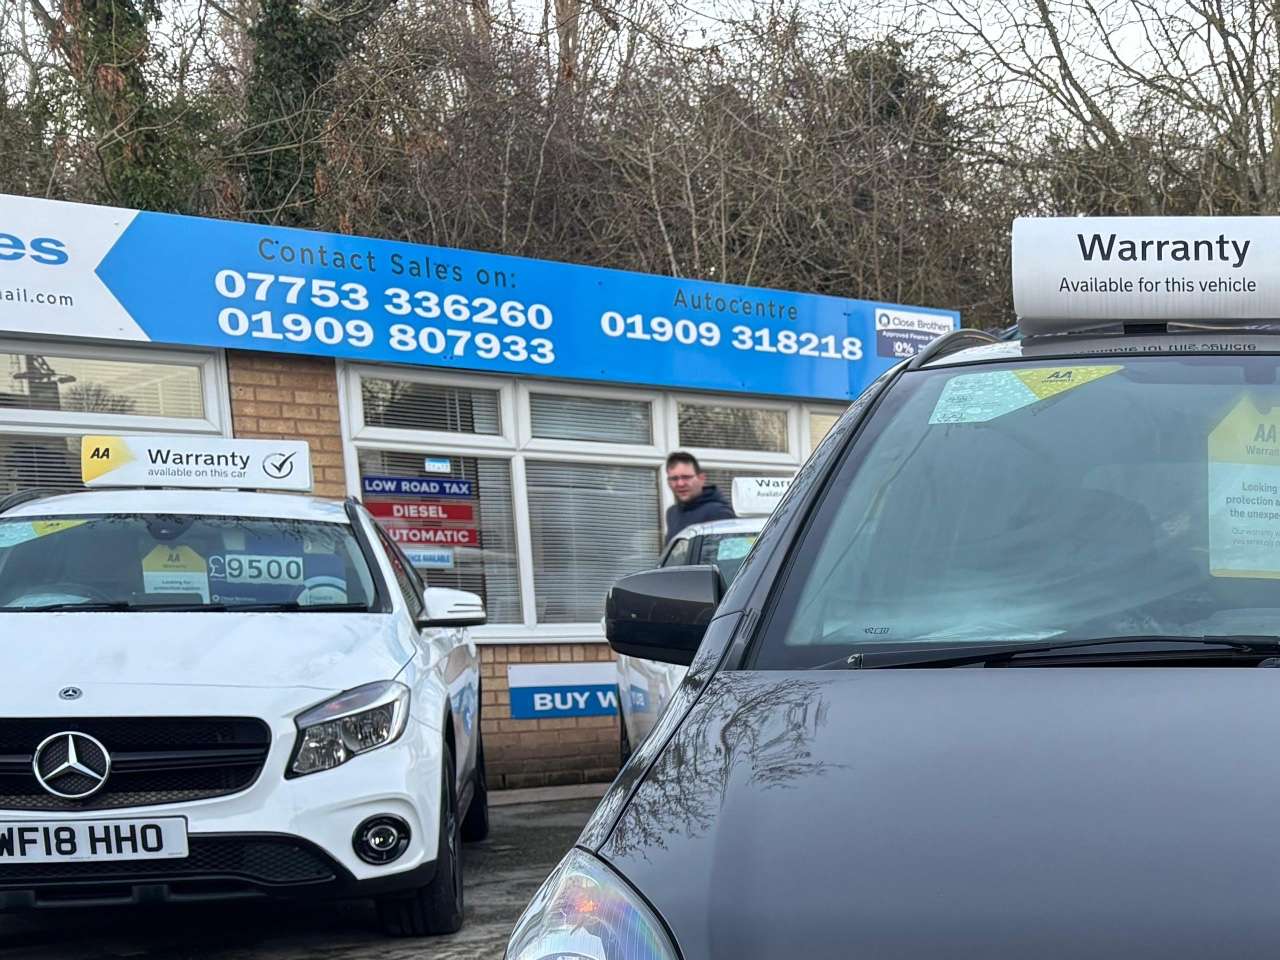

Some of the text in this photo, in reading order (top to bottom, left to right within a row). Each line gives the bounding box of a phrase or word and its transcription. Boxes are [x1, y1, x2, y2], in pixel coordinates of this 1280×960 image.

[1077, 234, 1250, 268] Warranty
[258, 238, 516, 288] Contact Sales on:
[1059, 277, 1257, 292] Available for this vehicle
[0, 288, 73, 306] ail.com
[215, 269, 553, 330] 07753 336260
[674, 288, 797, 320] Autocentre
[893, 316, 950, 332] Close Brothers
[218, 307, 555, 364] 01909 807933
[600, 311, 863, 360] 01909 318218
[1254, 424, 1277, 443] AA
[90, 447, 110, 459] AA
[148, 449, 250, 470] Warranty
[148, 467, 192, 477] available
[194, 470, 208, 478] on
[210, 469, 229, 478] this
[365, 480, 469, 494] LOW ROAD TAX
[1242, 482, 1277, 494] Looking
[1226, 496, 1273, 506] protection
[393, 505, 448, 518] DIESEL
[1230, 508, 1245, 518] the
[209, 554, 302, 580] £9500
[534, 692, 590, 711] BUY
[0, 824, 164, 856] WF18 HHO
